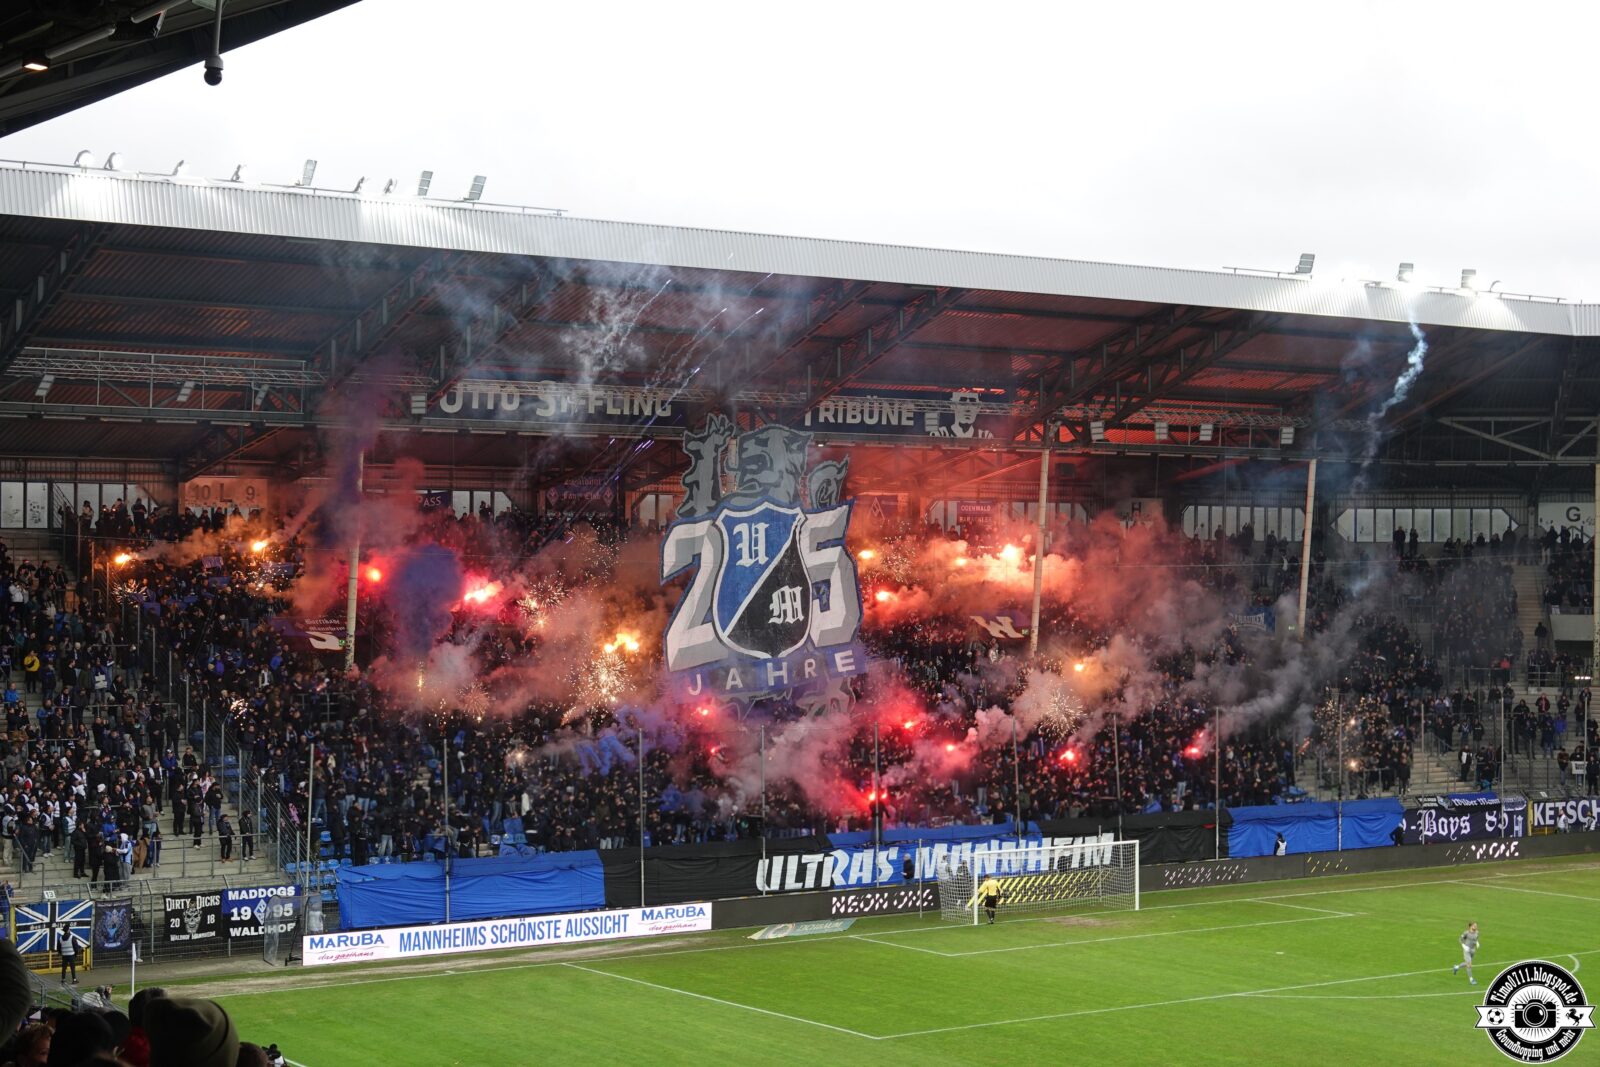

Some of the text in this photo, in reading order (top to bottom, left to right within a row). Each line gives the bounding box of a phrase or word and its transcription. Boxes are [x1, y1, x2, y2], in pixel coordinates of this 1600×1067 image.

[220, 483, 233, 502] L
[245, 485, 256, 501] 9
[1566, 506, 1581, 522] G
[688, 651, 855, 696] JAHRE
[756, 846, 899, 891] ULTRAS
[228, 886, 296, 901] MADDOGS
[165, 894, 220, 912] DIRTY DICKS
[230, 906, 252, 920] 19
[273, 903, 293, 918] 95
[170, 918, 180, 928] 20
[229, 922, 297, 937] WALDHOF
[400, 914, 629, 952] MANNHEIMS SCHÖNSTE AUSSICHT
